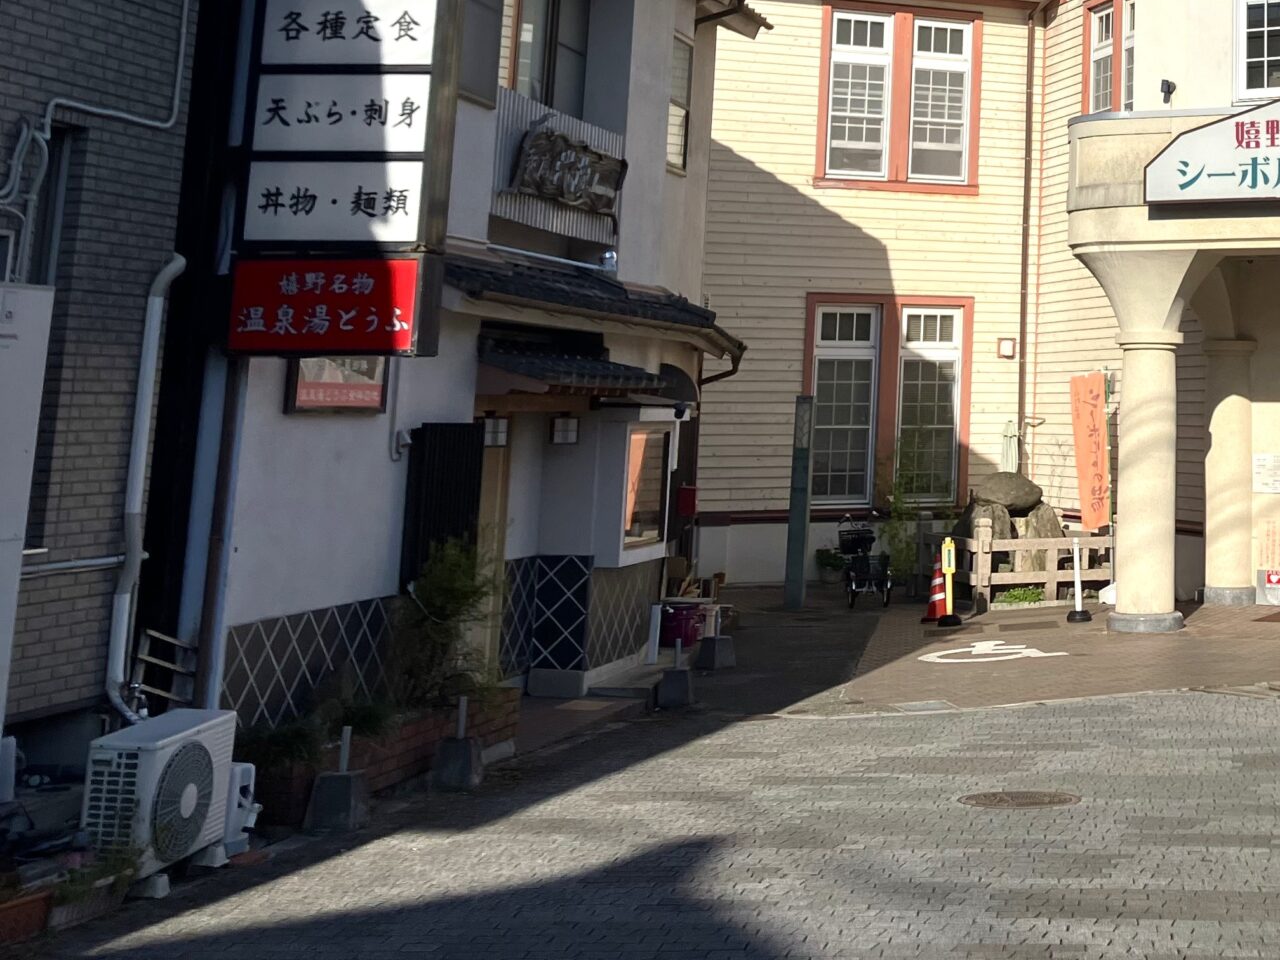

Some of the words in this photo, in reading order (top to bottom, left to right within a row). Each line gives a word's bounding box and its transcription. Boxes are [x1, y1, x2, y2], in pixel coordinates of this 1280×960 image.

[277, 10, 421, 42] 各種定食
[262, 96, 421, 128] 天ぷら・刺身
[257, 185, 410, 218] 丼物・麺類
[278, 271, 375, 295] 嬉野名物
[237, 304, 409, 335] 温泉湯どうふ
